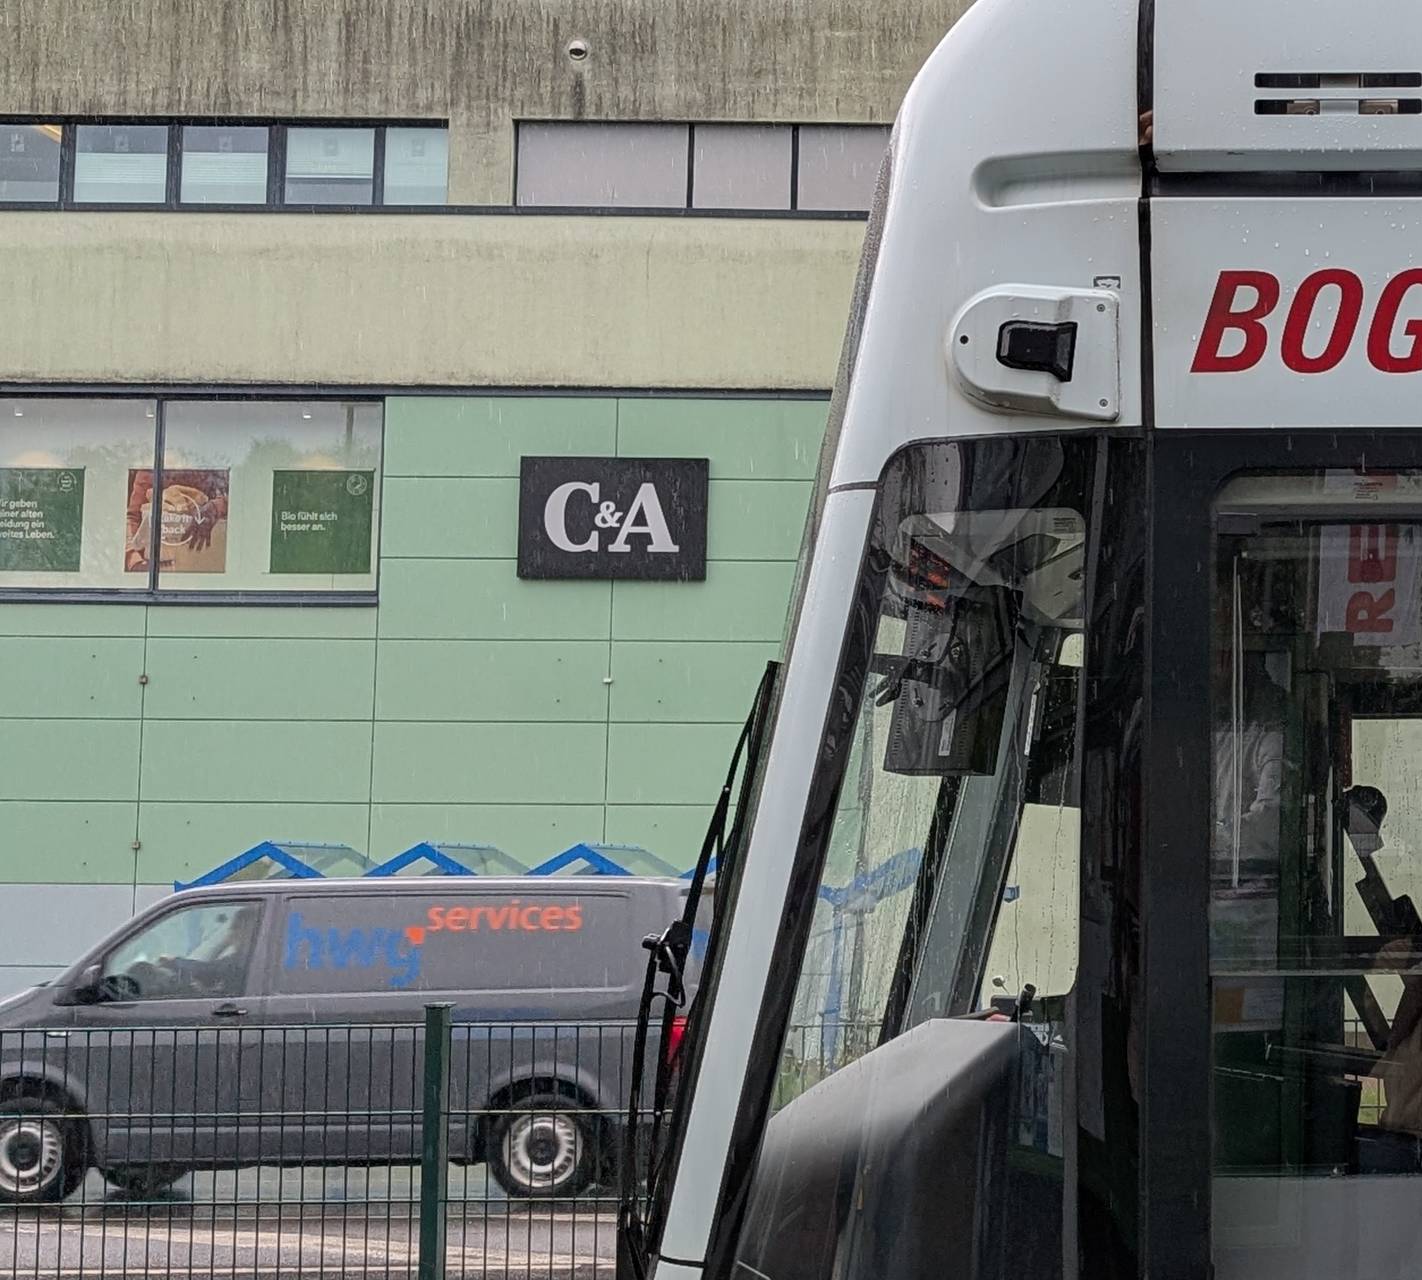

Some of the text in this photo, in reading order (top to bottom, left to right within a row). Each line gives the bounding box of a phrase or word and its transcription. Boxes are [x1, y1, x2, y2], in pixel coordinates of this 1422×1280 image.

[9, 498, 38, 510] geben
[20, 509, 44, 519] alten
[280, 511, 296, 521] Bio
[319, 511, 338, 521] sich
[543, 481, 680, 553] C&A
[31, 519, 45, 529] ein
[280, 520, 310, 531] besser
[25, 529, 56, 539] Leben.
[427, 899, 582, 932] services
[283, 912, 421, 988] hwg
